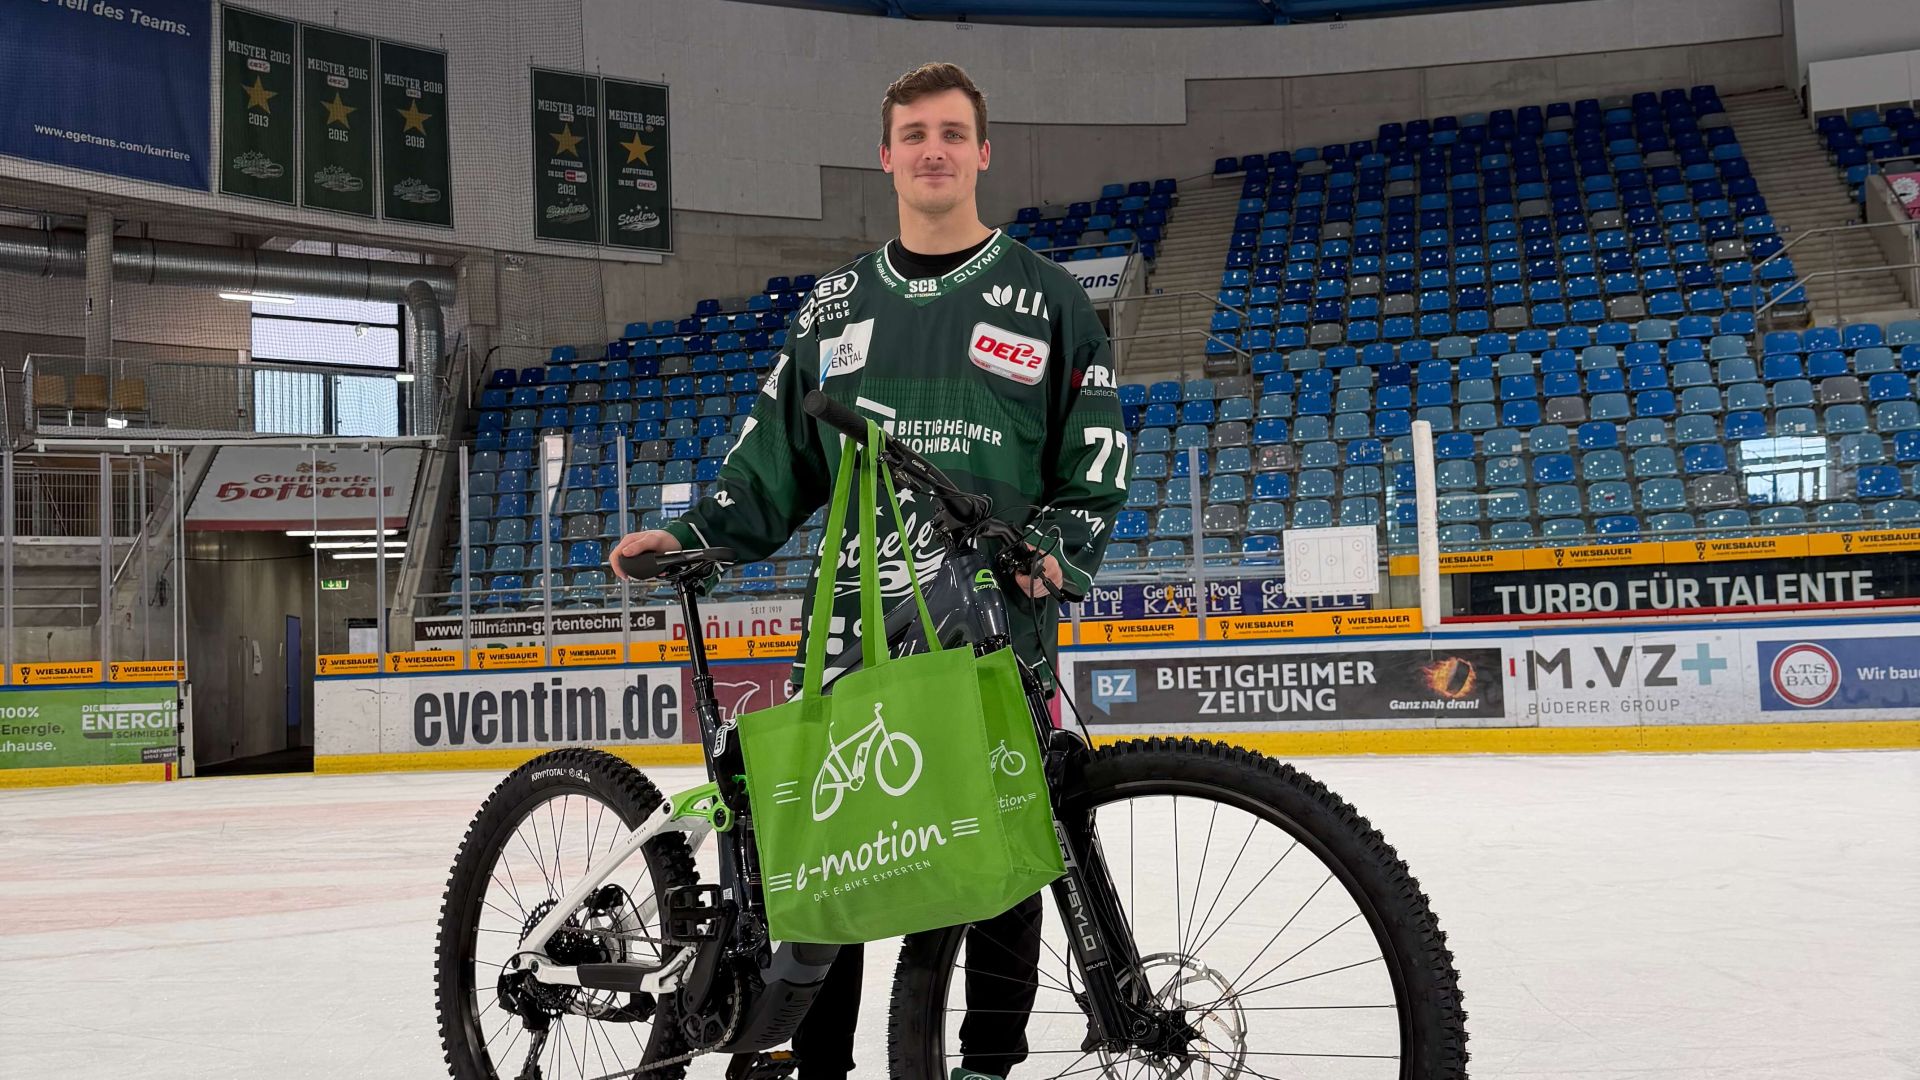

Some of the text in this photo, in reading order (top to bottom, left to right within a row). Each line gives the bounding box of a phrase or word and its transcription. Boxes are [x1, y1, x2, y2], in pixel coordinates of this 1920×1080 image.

[92, 1, 125, 21] des
[130, 9, 191, 36] Teams.
[228, 40, 291, 65] MEISTER 2013
[307, 58, 368, 80] MEISTER 2015
[384, 73, 421, 91] MEISTER
[423, 81, 443, 94] 2018
[538, 99, 595, 117] MEISTER 2021
[249, 113, 269, 128] 2013
[608, 109, 665, 126] MEISTER 2025
[34, 123, 191, 162] www.egetrans.com/karriere
[328, 128, 349, 142] 2015
[405, 135, 425, 149] 2018
[557, 183, 577, 196] 2021
[618, 210, 658, 226] Steelers
[953, 245, 1001, 283] OLYMP
[909, 279, 938, 293] SCB
[1074, 273, 1119, 289] rans
[897, 419, 1003, 447] BIETIGHEIMER
[1083, 427, 1128, 490] 77
[254, 474, 376, 484] Stuttgarte
[1858, 528, 1920, 543] WIESBAUE
[1570, 548, 1632, 557] WIESBAUER
[1712, 540, 1776, 550] WIESBAUER
[1093, 587, 1123, 601] Pool
[1211, 582, 1241, 597] Pool
[1494, 570, 1874, 615] TURBO FÜR TALENTE
[1235, 620, 1294, 629] WIESBAUER
[1347, 615, 1410, 624] WIESBAUER
[1118, 624, 1174, 632] WIESBAUER
[489, 652, 538, 660] WIESBAUER
[570, 649, 616, 657] WIESBAUER
[36, 667, 93, 676] WIESBAUER
[1157, 661, 1377, 690] BIETIGHEIMER
[1785, 663, 1829, 675] A.T.S.
[1857, 666, 1920, 680] Wir bau
[1097, 674, 1132, 697] BZ
[1786, 675, 1827, 687] BAU
[1198, 688, 1337, 714] ZEITUNG
[1390, 699, 1479, 710] Ganz nah dran!
[1621, 699, 1680, 713] GROUP
[414, 674, 678, 746] eventim.de
[2, 722, 65, 736] Energie,
[116, 730, 170, 739] SCHMIEDE
[531, 768, 565, 782] KRYPTOTAL
[796, 821, 946, 891] e-motion
[833, 877, 870, 896] E-BIKE
[873, 860, 931, 882] EXPERTEN
[1062, 876, 1097, 951] PSYLO
